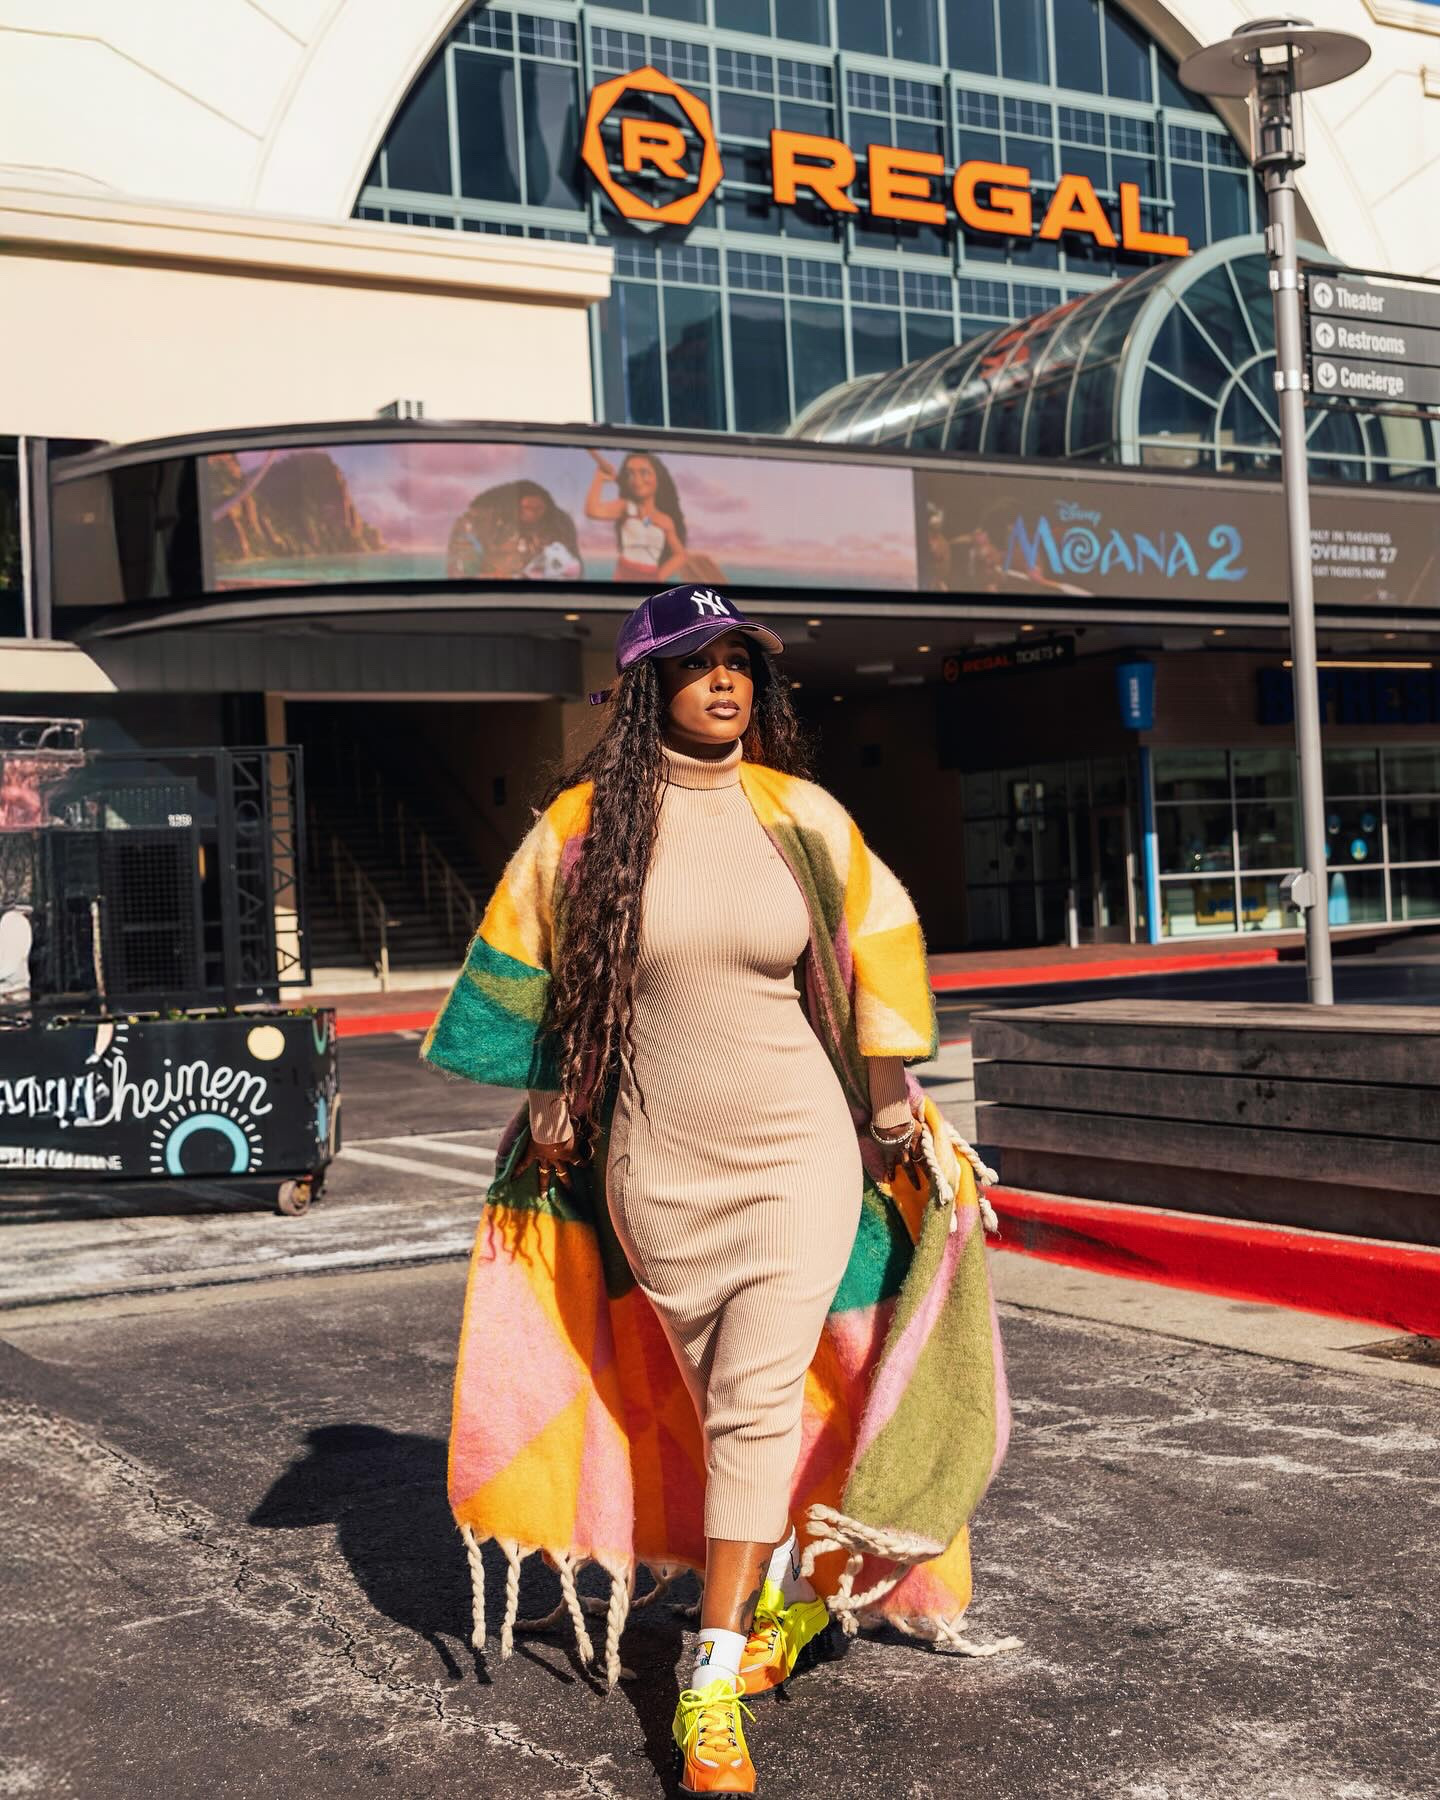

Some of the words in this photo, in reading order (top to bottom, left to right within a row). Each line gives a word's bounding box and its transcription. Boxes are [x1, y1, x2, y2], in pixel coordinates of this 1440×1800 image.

[621, 118, 688, 180] R
[771, 129, 1190, 258] REGAL
[1336, 287, 1385, 313] Theater
[1337, 327, 1406, 355] Restrooms
[1340, 366, 1404, 397] Concierge
[1332, 531, 1345, 542] IN
[1206, 523, 1248, 581] 2
[1311, 543, 1377, 562] OVEMBER
[1379, 547, 1398, 564] 27
[690, 590, 730, 616] NY
[963, 655, 1009, 673] REGAL
